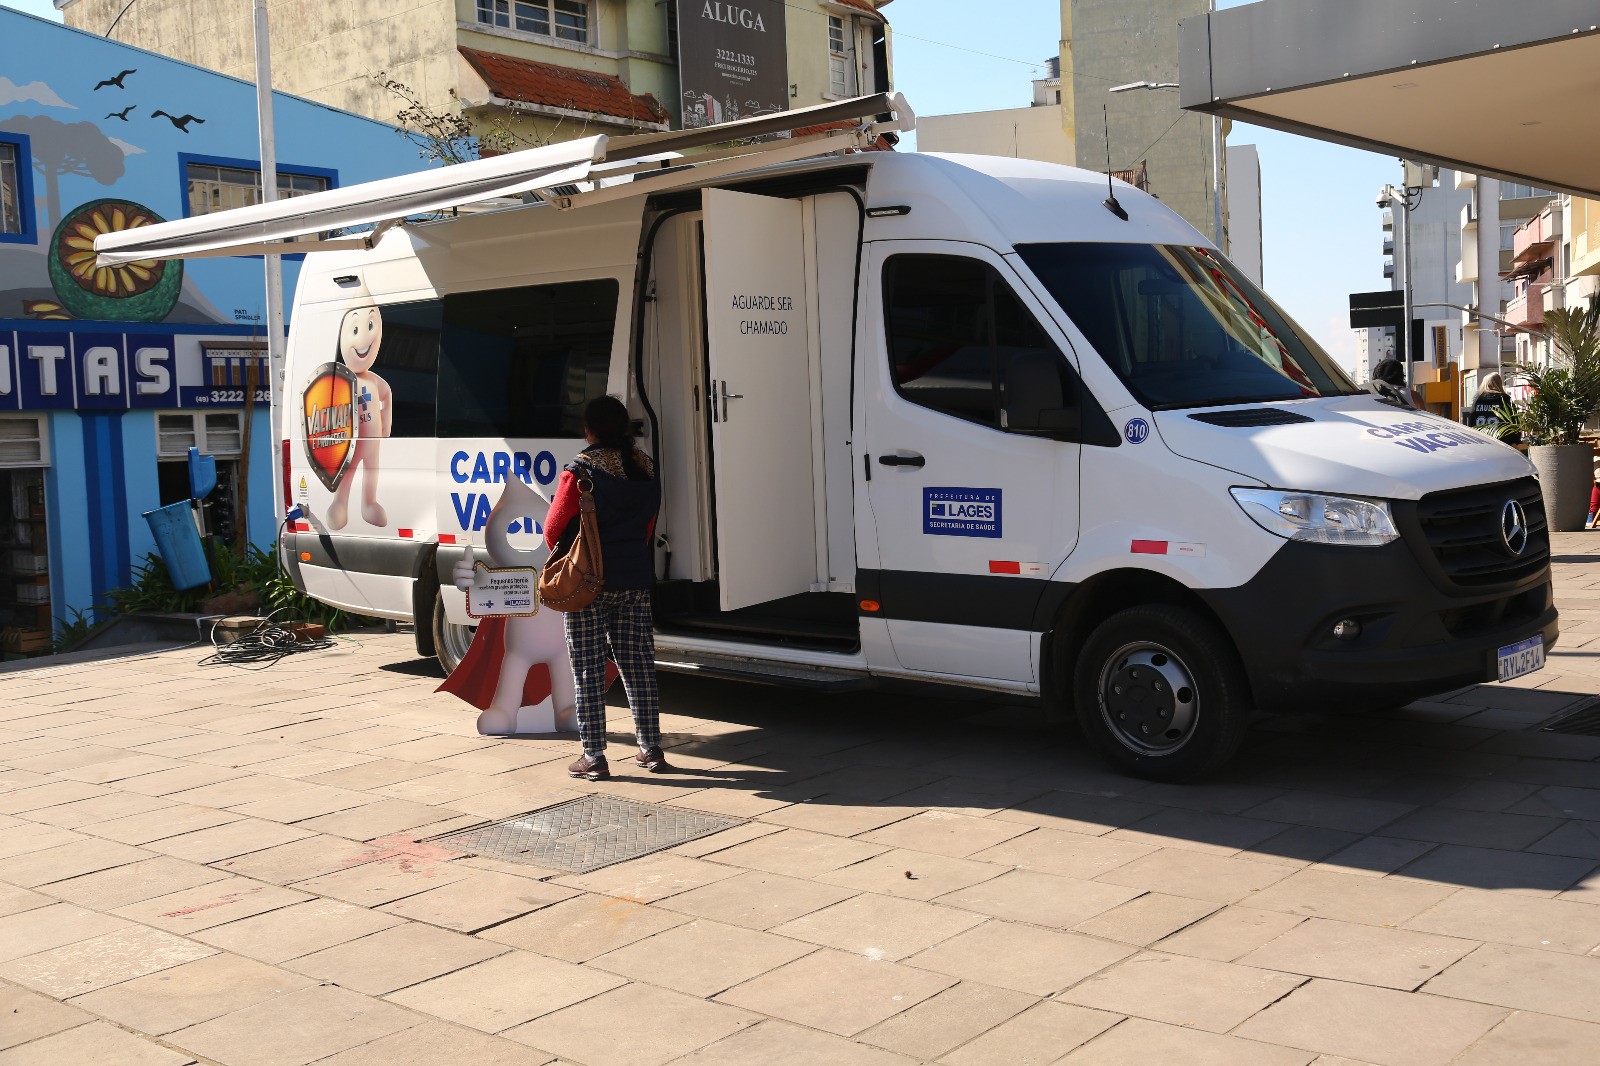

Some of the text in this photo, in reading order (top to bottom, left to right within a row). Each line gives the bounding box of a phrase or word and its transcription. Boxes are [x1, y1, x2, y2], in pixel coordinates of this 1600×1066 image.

[701, 0, 766, 33] ALUGA
[715, 48, 755, 67] 3222.1333
[731, 294, 794, 311] AGUARDE SER
[739, 320, 788, 335] CHAMADO
[210, 390, 245, 403] 3222
[307, 402, 352, 436] VACINAR
[359, 412, 372, 424] SUS
[1127, 423, 1146, 439] 810
[450, 450, 557, 486] CARRO
[929, 493, 980, 501] PREFEITURA
[948, 503, 993, 519] LAGES
[929, 521, 965, 530] SECRETARIA
[975, 522, 996, 531] SAÚDE
[1503, 647, 1541, 678] RYL2F14
